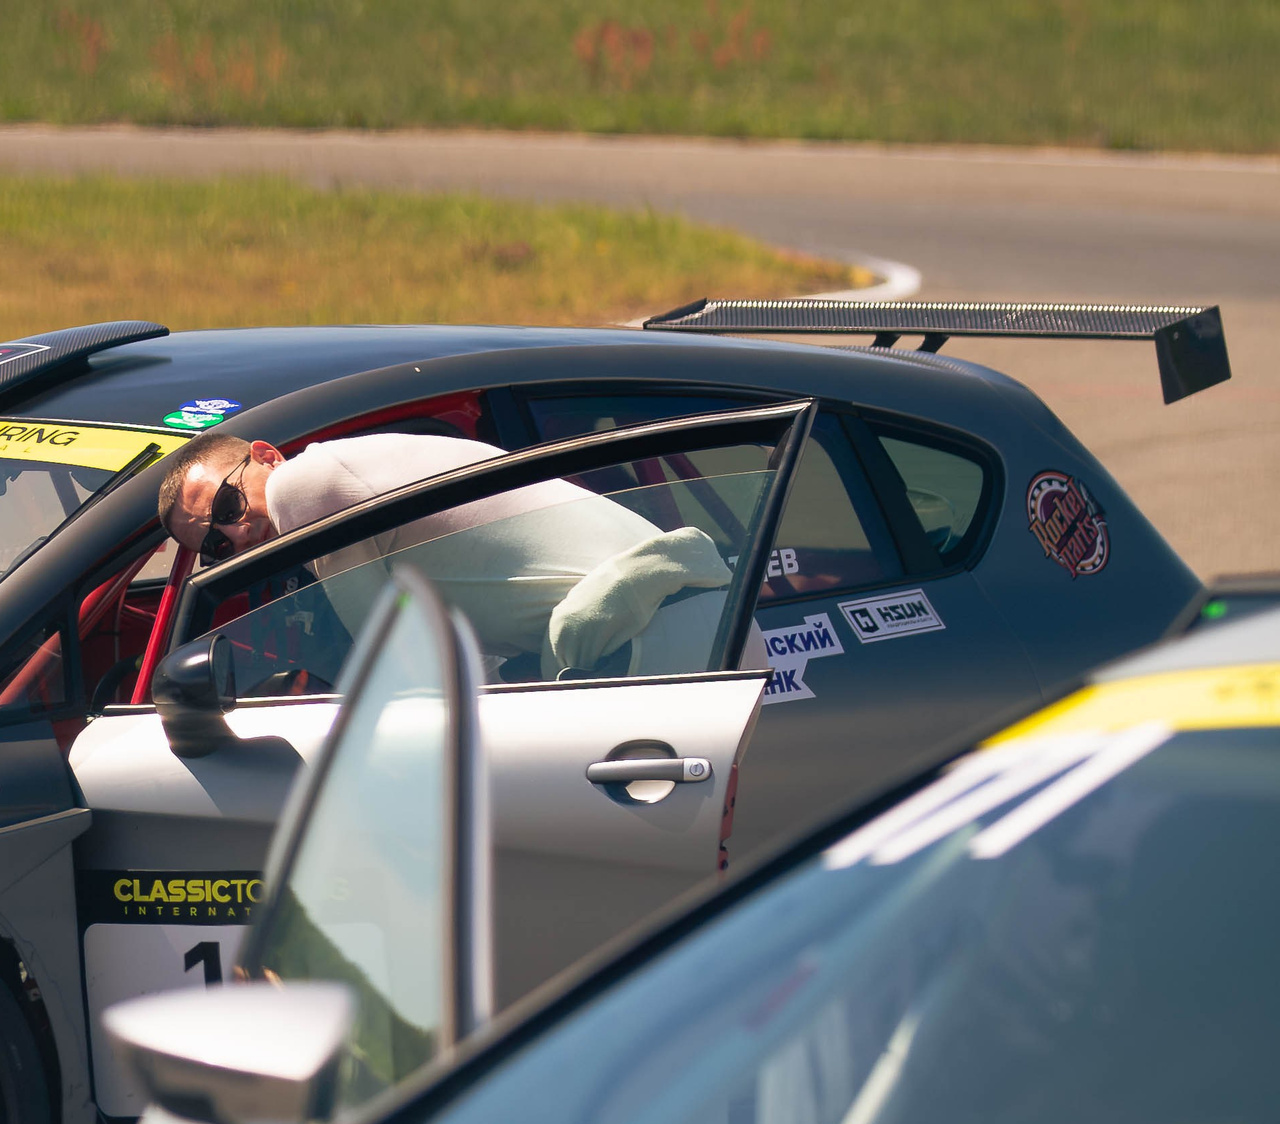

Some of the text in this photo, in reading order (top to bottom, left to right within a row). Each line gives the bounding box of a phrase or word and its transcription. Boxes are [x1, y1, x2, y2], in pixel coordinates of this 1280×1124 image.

[1029, 477, 1086, 556] Rocket
[765, 669, 802, 696] НК
[113, 879, 266, 903] CLASSICTO
[124, 906, 252, 917] INTERNAT
